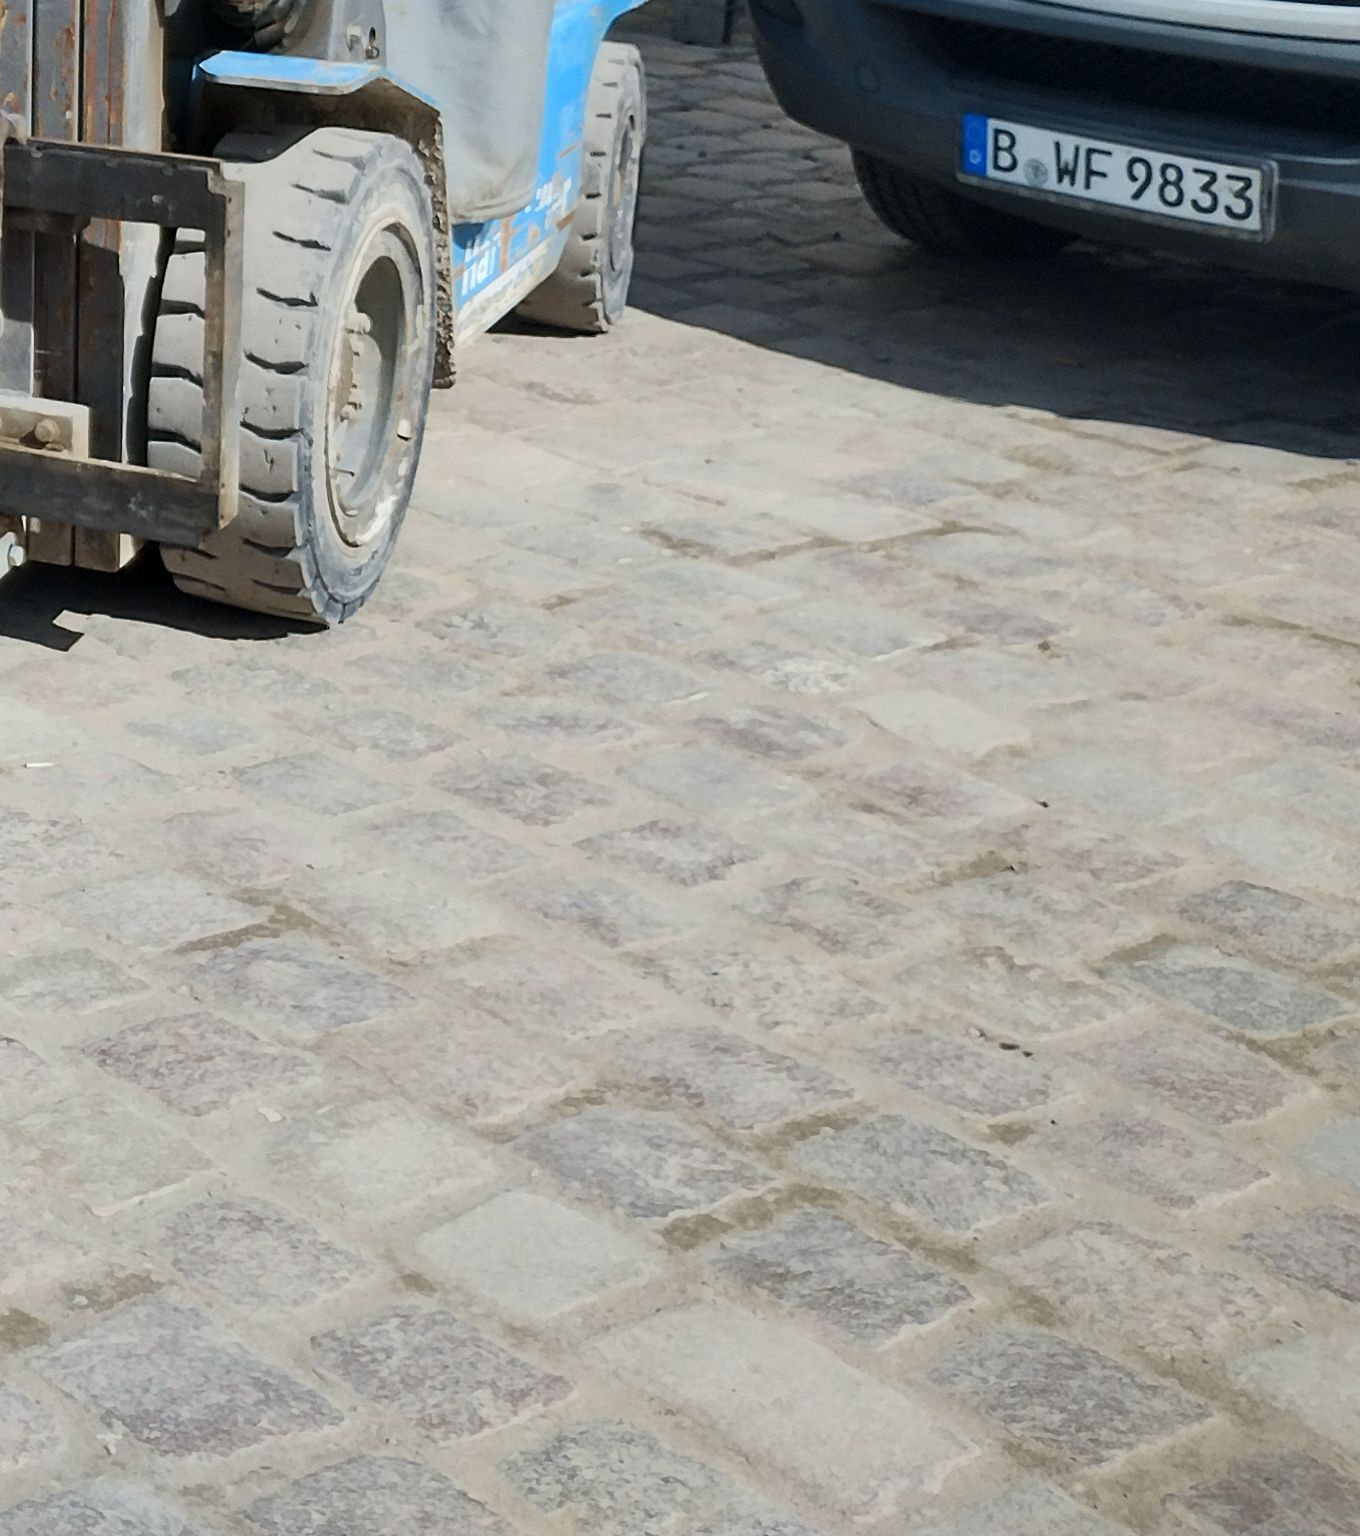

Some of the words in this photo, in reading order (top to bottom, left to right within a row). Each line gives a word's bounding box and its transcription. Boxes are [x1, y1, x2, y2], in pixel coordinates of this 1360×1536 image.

[992, 128, 1018, 173] B
[1054, 140, 1112, 190] WF
[1126, 156, 1254, 221] 9833
